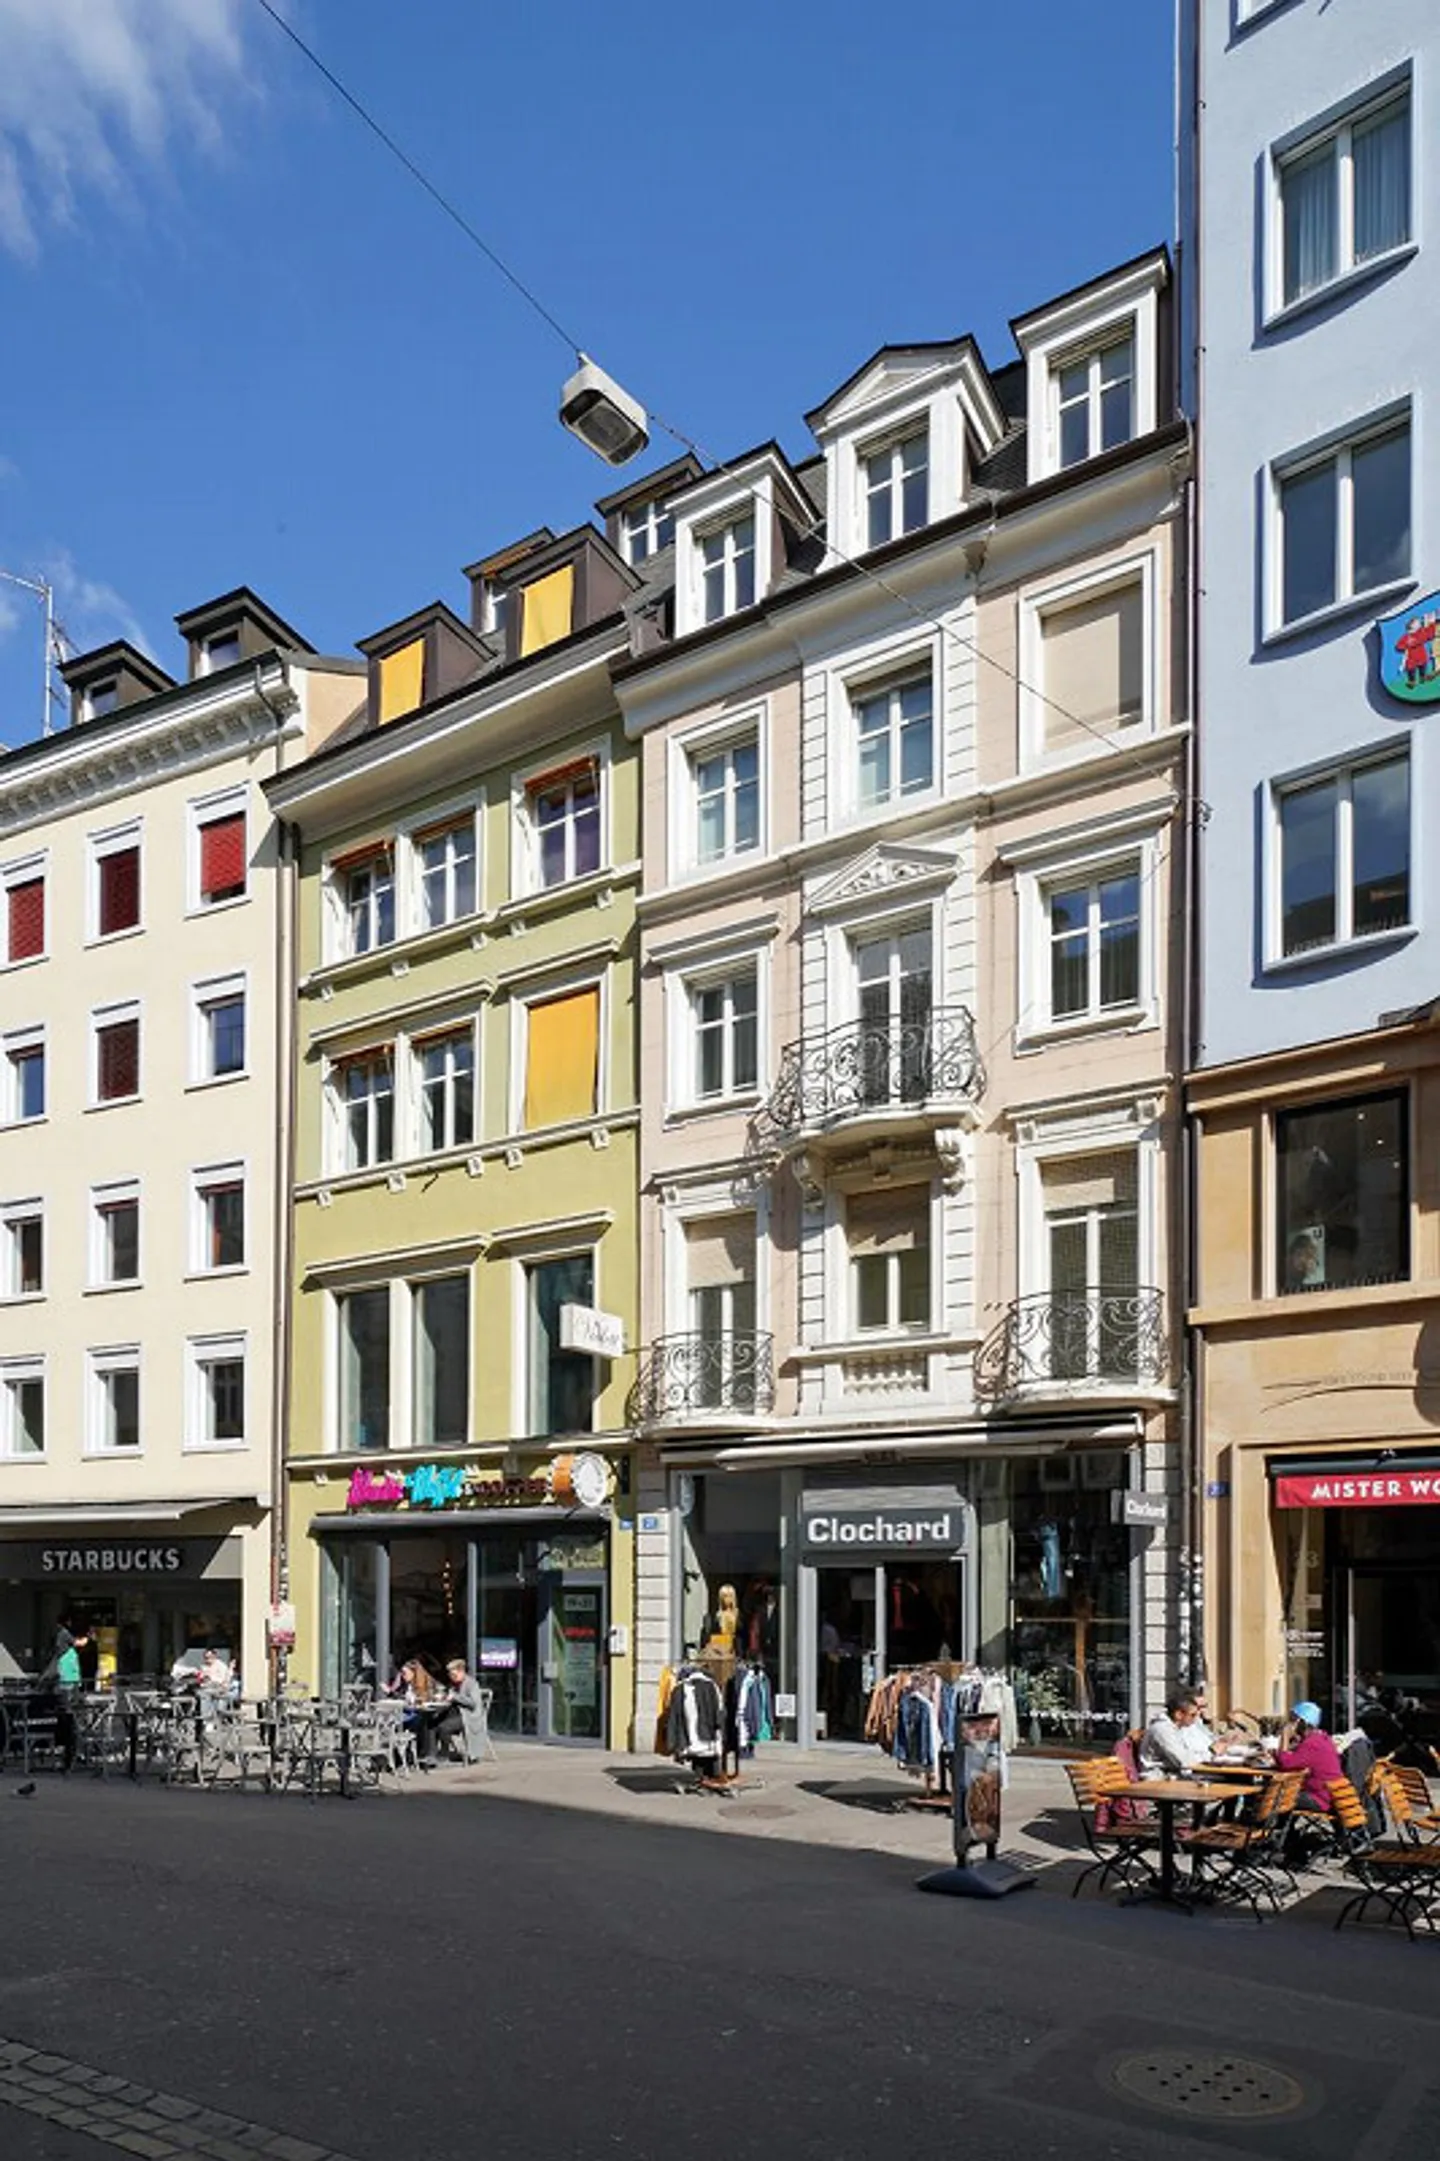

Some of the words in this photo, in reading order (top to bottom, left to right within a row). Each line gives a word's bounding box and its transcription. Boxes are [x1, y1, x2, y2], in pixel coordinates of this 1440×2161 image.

[1311, 1480, 1402, 1500] MISTER
[807, 1514, 951, 1542] Clochard
[41, 1547, 181, 1572] STARBUCKS
